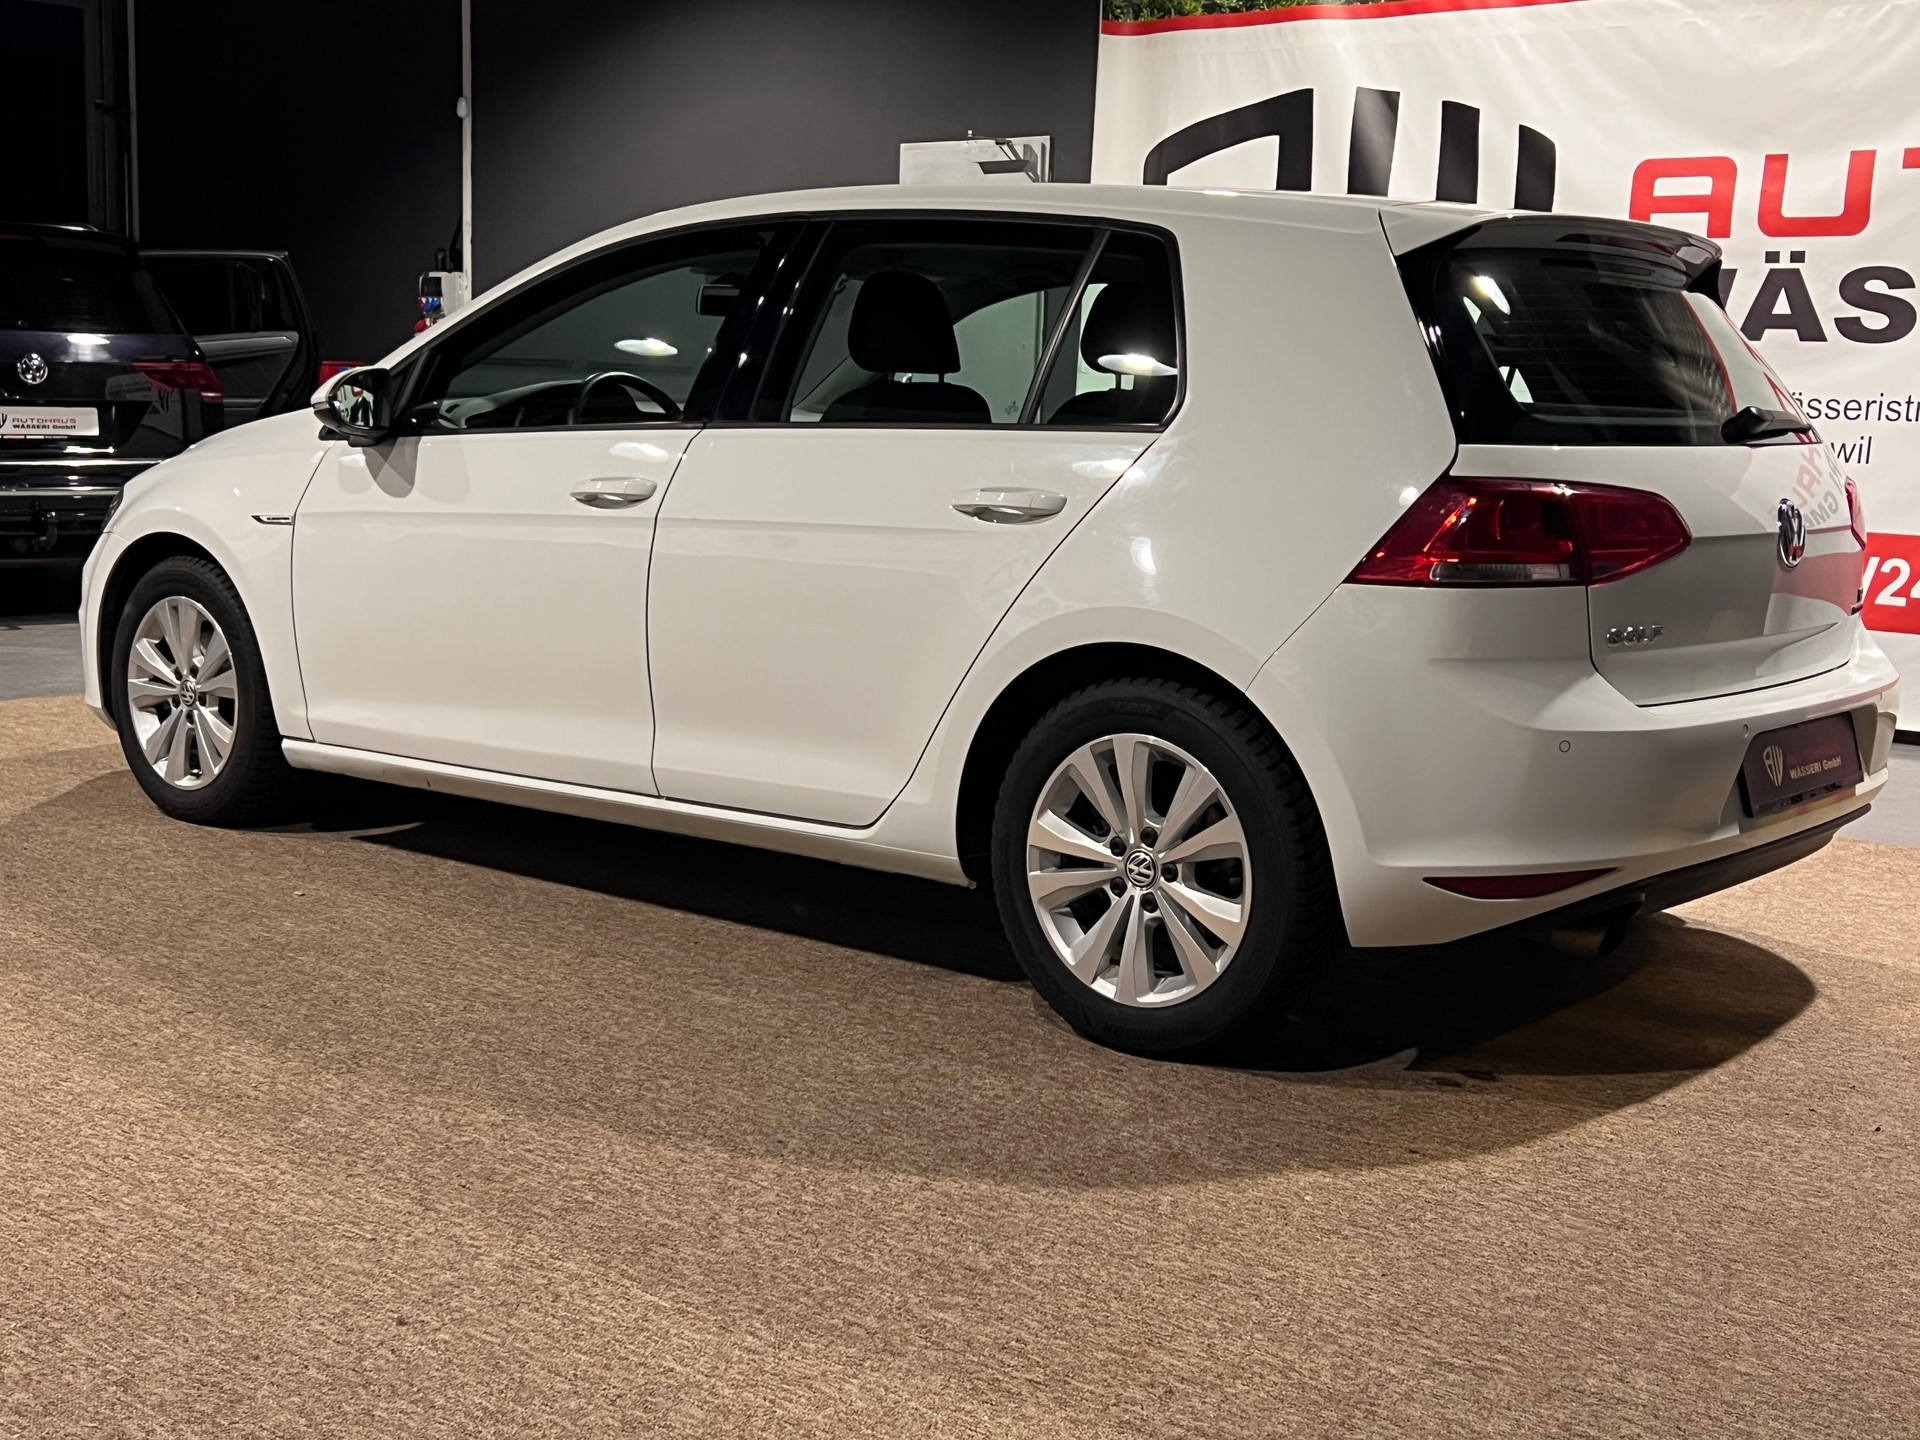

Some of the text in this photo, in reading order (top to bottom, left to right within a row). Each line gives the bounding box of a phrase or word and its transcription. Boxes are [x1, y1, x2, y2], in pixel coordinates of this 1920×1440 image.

[1629, 147, 1920, 239] AU
[1717, 250, 1918, 344] ÄS
[1606, 624, 1664, 647] GOLF
[1822, 755, 1842, 770] GmbH
